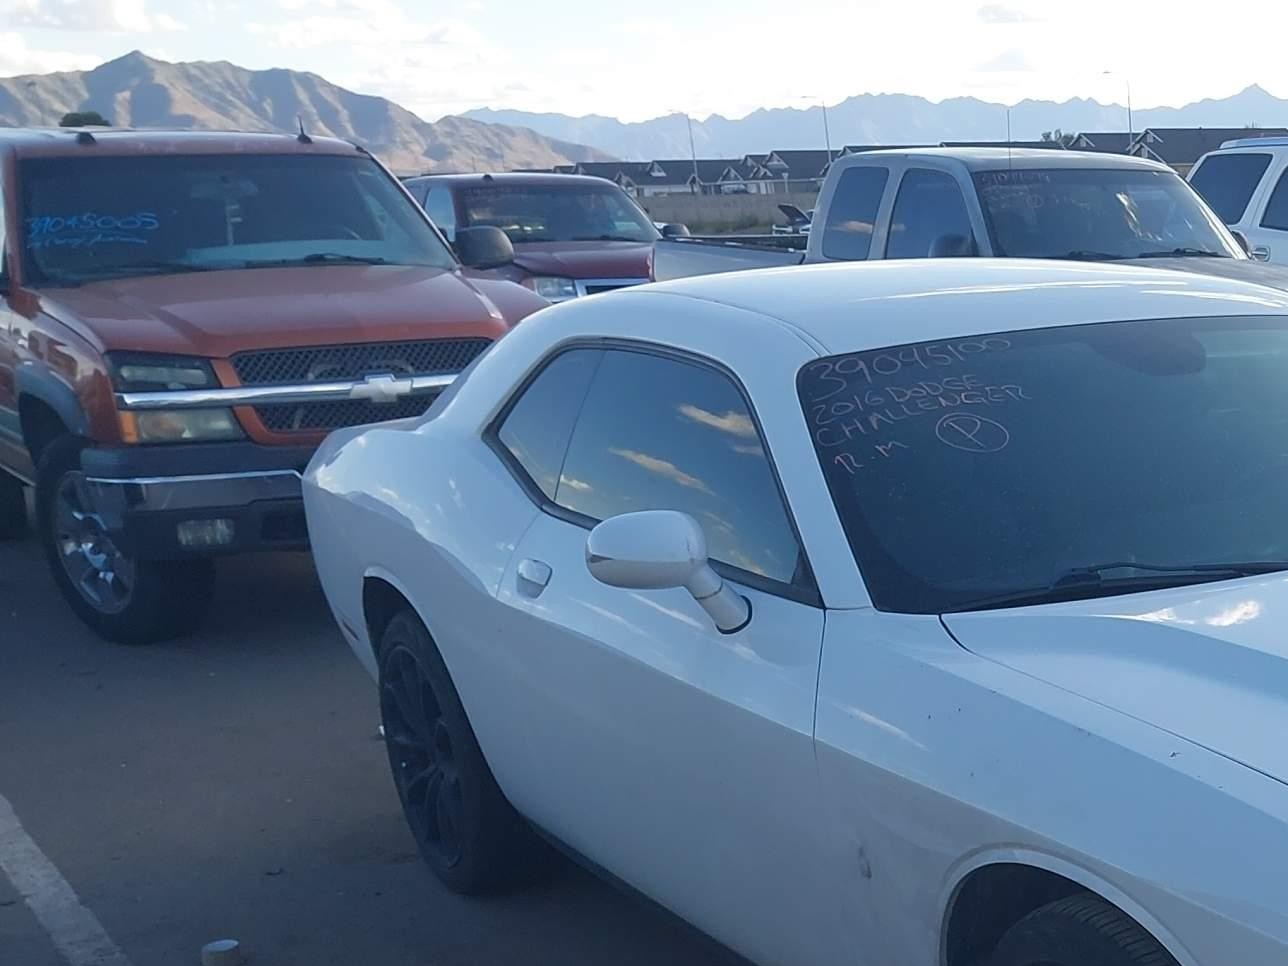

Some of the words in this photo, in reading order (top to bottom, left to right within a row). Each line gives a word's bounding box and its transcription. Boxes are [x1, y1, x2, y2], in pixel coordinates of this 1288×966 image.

[809, 338, 1011, 401] 39045100
[812, 390, 884, 425] 2016
[885, 374, 983, 402] DODGE
[816, 385, 1032, 447] CHALLENGER
